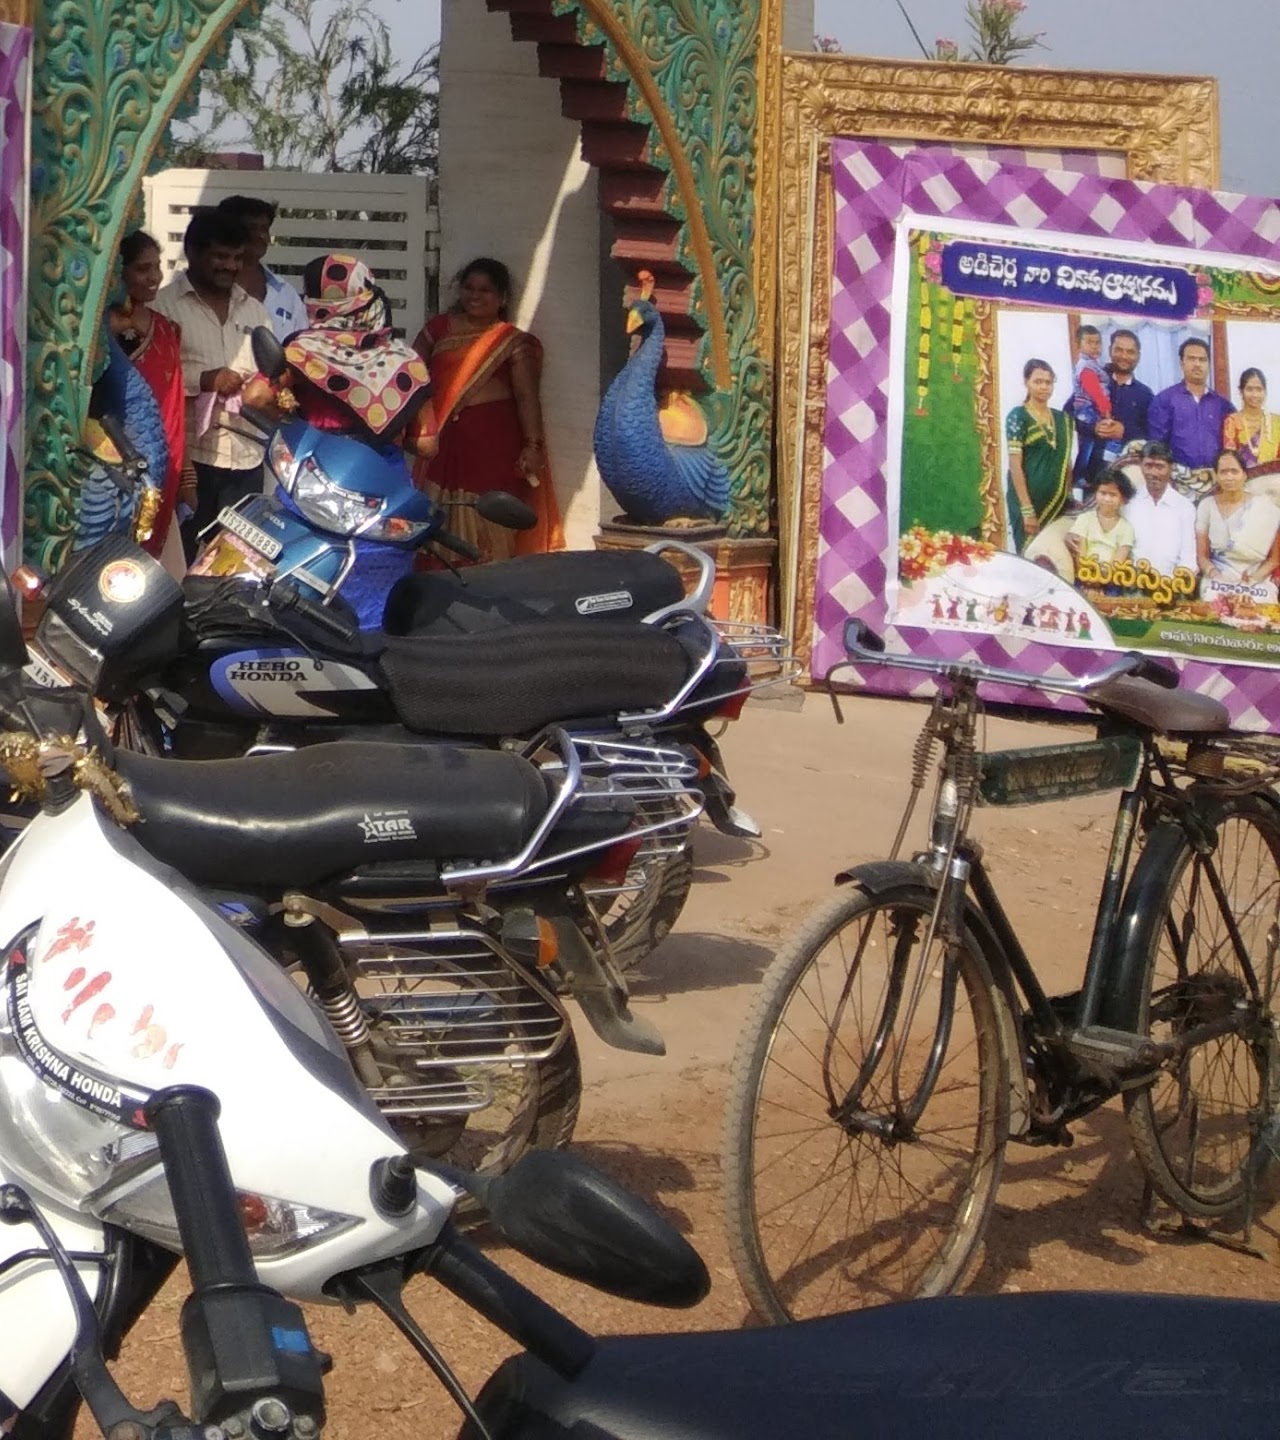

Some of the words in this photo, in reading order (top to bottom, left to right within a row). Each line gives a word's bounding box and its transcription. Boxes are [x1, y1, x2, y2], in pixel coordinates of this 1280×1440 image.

[1077, 553, 1197, 604] మనస్విని
[230, 671, 309, 682] HONDA
[237, 660, 300, 671] HERO
[15, 972, 28, 997] SAI
[16, 996, 31, 1029] RAM
[22, 1026, 71, 1082] KRISHNA
[70, 1071, 123, 1109] HONDA
